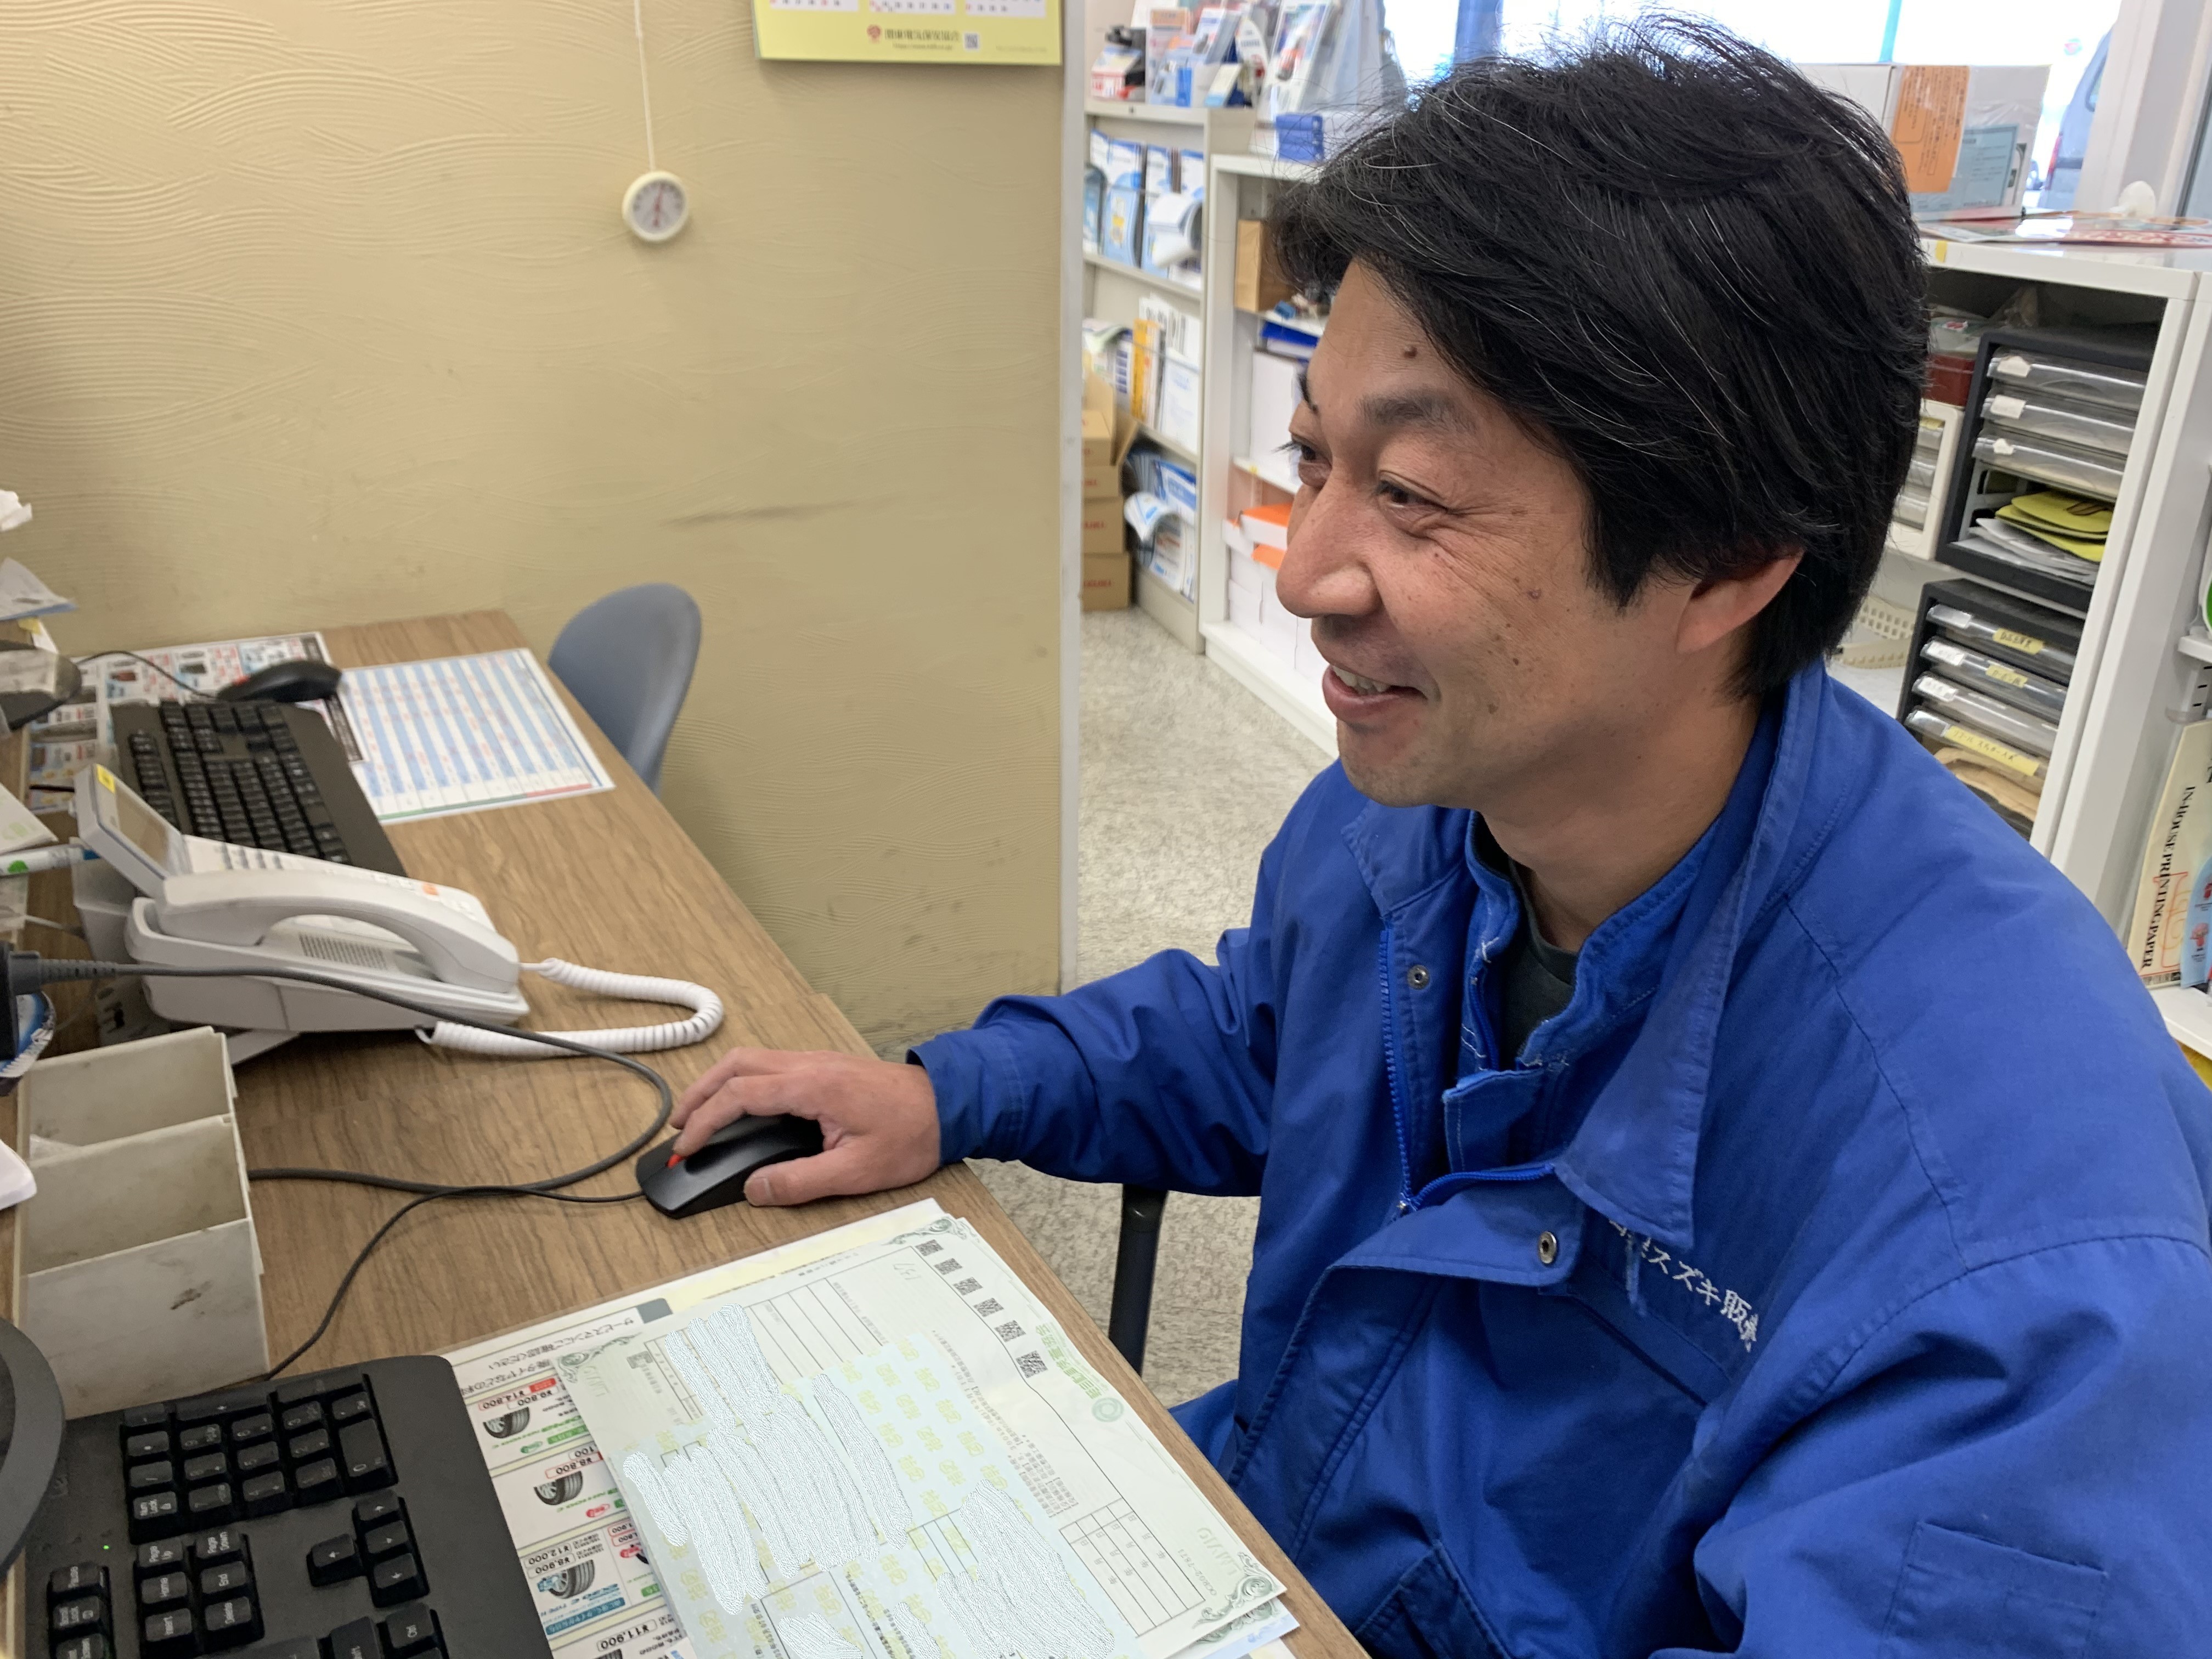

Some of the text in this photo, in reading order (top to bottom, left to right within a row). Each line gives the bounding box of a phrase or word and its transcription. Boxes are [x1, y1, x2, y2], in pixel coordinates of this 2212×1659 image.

[2141, 786, 2196, 969] IN-HOUSE PRINTING PAPER
[556, 1457, 592, 1475] ¥8,800
[149, 1545, 160, 1562] Page
[535, 1557, 570, 1575] ¥8,900
[160, 1577, 170, 1598] Home
[218, 1573, 229, 1587] End
[224, 1602, 235, 1624] Delete
[600, 1624, 648, 1650] ¥11,900
